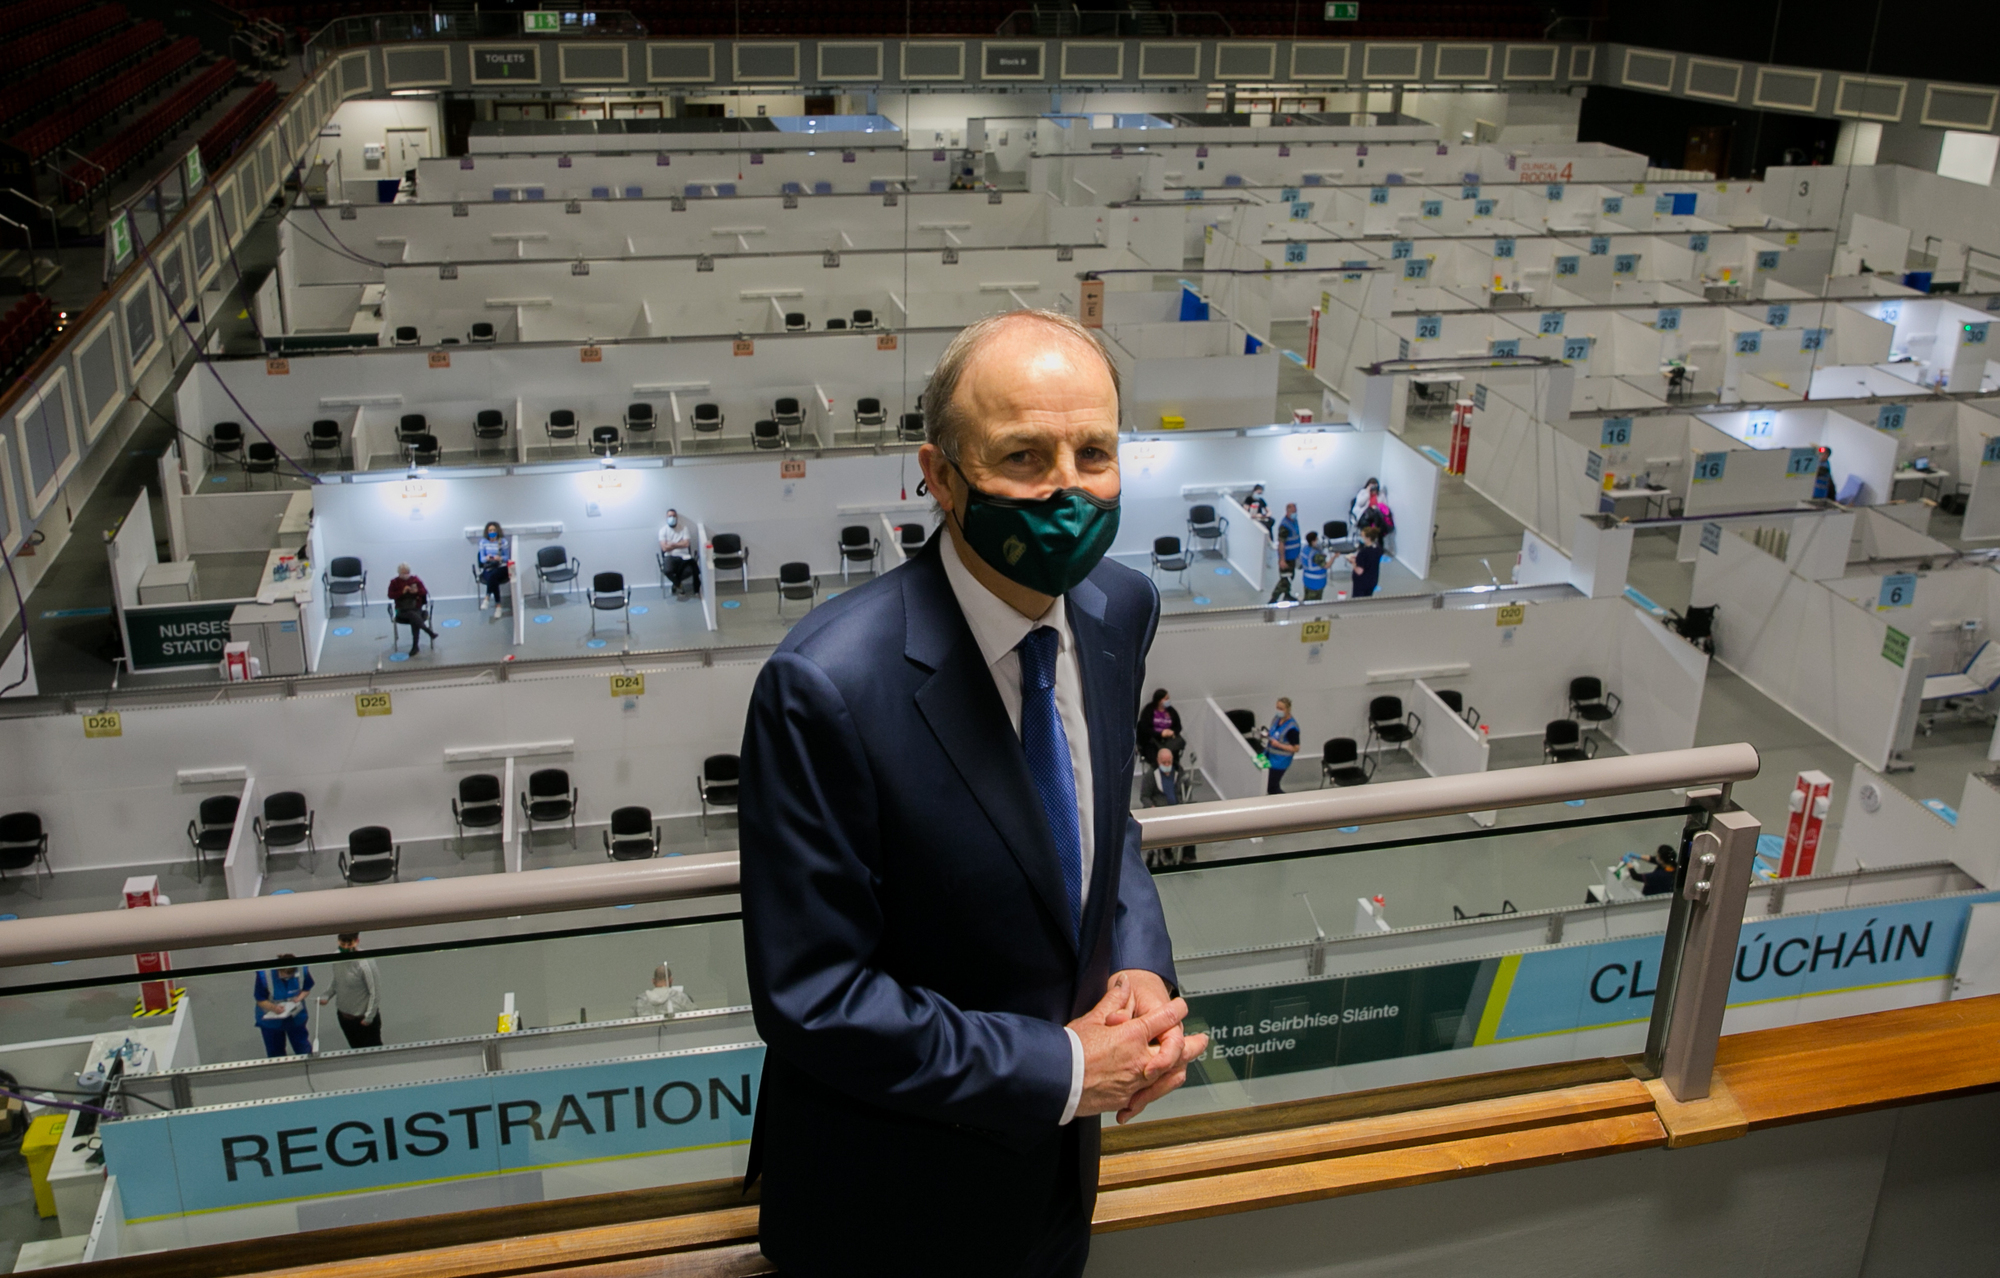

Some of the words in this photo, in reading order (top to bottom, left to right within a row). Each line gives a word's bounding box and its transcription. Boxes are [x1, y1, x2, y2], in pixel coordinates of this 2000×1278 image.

[485, 54, 525, 63] TOILETS
[1520, 171, 1558, 182] ROOM
[1560, 161, 1573, 184] 4
[1798, 181, 1809, 197] 3
[1293, 208, 1306, 218] 47
[1427, 207, 1440, 216] 48
[1477, 205, 1490, 215] 49
[1289, 251, 1304, 262] 36
[1395, 248, 1410, 259] 37
[1497, 246, 1512, 257] 38
[1561, 263, 1576, 274] 38
[1617, 261, 1632, 272] 39
[1761, 257, 1775, 268] 40
[1408, 266, 1423, 277] 37
[1088, 306, 1097, 317] E
[1880, 309, 1898, 322] 30
[1660, 317, 1677, 329] 28
[1768, 313, 1785, 325] 29
[1420, 325, 1437, 338] 26
[1543, 321, 1560, 333] 27
[880, 337, 894, 346] E21
[1967, 330, 1984, 342] 30
[736, 343, 751, 351] E22
[1740, 340, 1757, 352] 28
[1804, 337, 1820, 349] 29
[431, 354, 446, 362] E24
[583, 349, 598, 357] E23
[1566, 346, 1584, 358] 27
[269, 361, 286, 370] E25
[1883, 414, 1901, 428] 18
[1751, 421, 1769, 435] 17
[1607, 429, 1626, 443] 16
[784, 463, 801, 472] E11
[1700, 462, 1720, 477] 16
[1794, 458, 1814, 471] 17
[1890, 587, 1902, 604] 6
[1500, 607, 1521, 619] D20
[159, 620, 231, 638] NURSES
[1305, 623, 1326, 635] D21
[615, 676, 640, 689] D24
[360, 696, 387, 708] D25
[89, 717, 116, 729] D26
[1589, 917, 1933, 1004] CLÚCHÁIN
[1232, 1024, 1255, 1038] na
[1258, 1012, 1339, 1034] Seirbhíse
[1342, 1004, 1399, 1024] Sláinte
[1212, 1038, 1296, 1060] Executive
[221, 1073, 752, 1183] REGISTRATION
